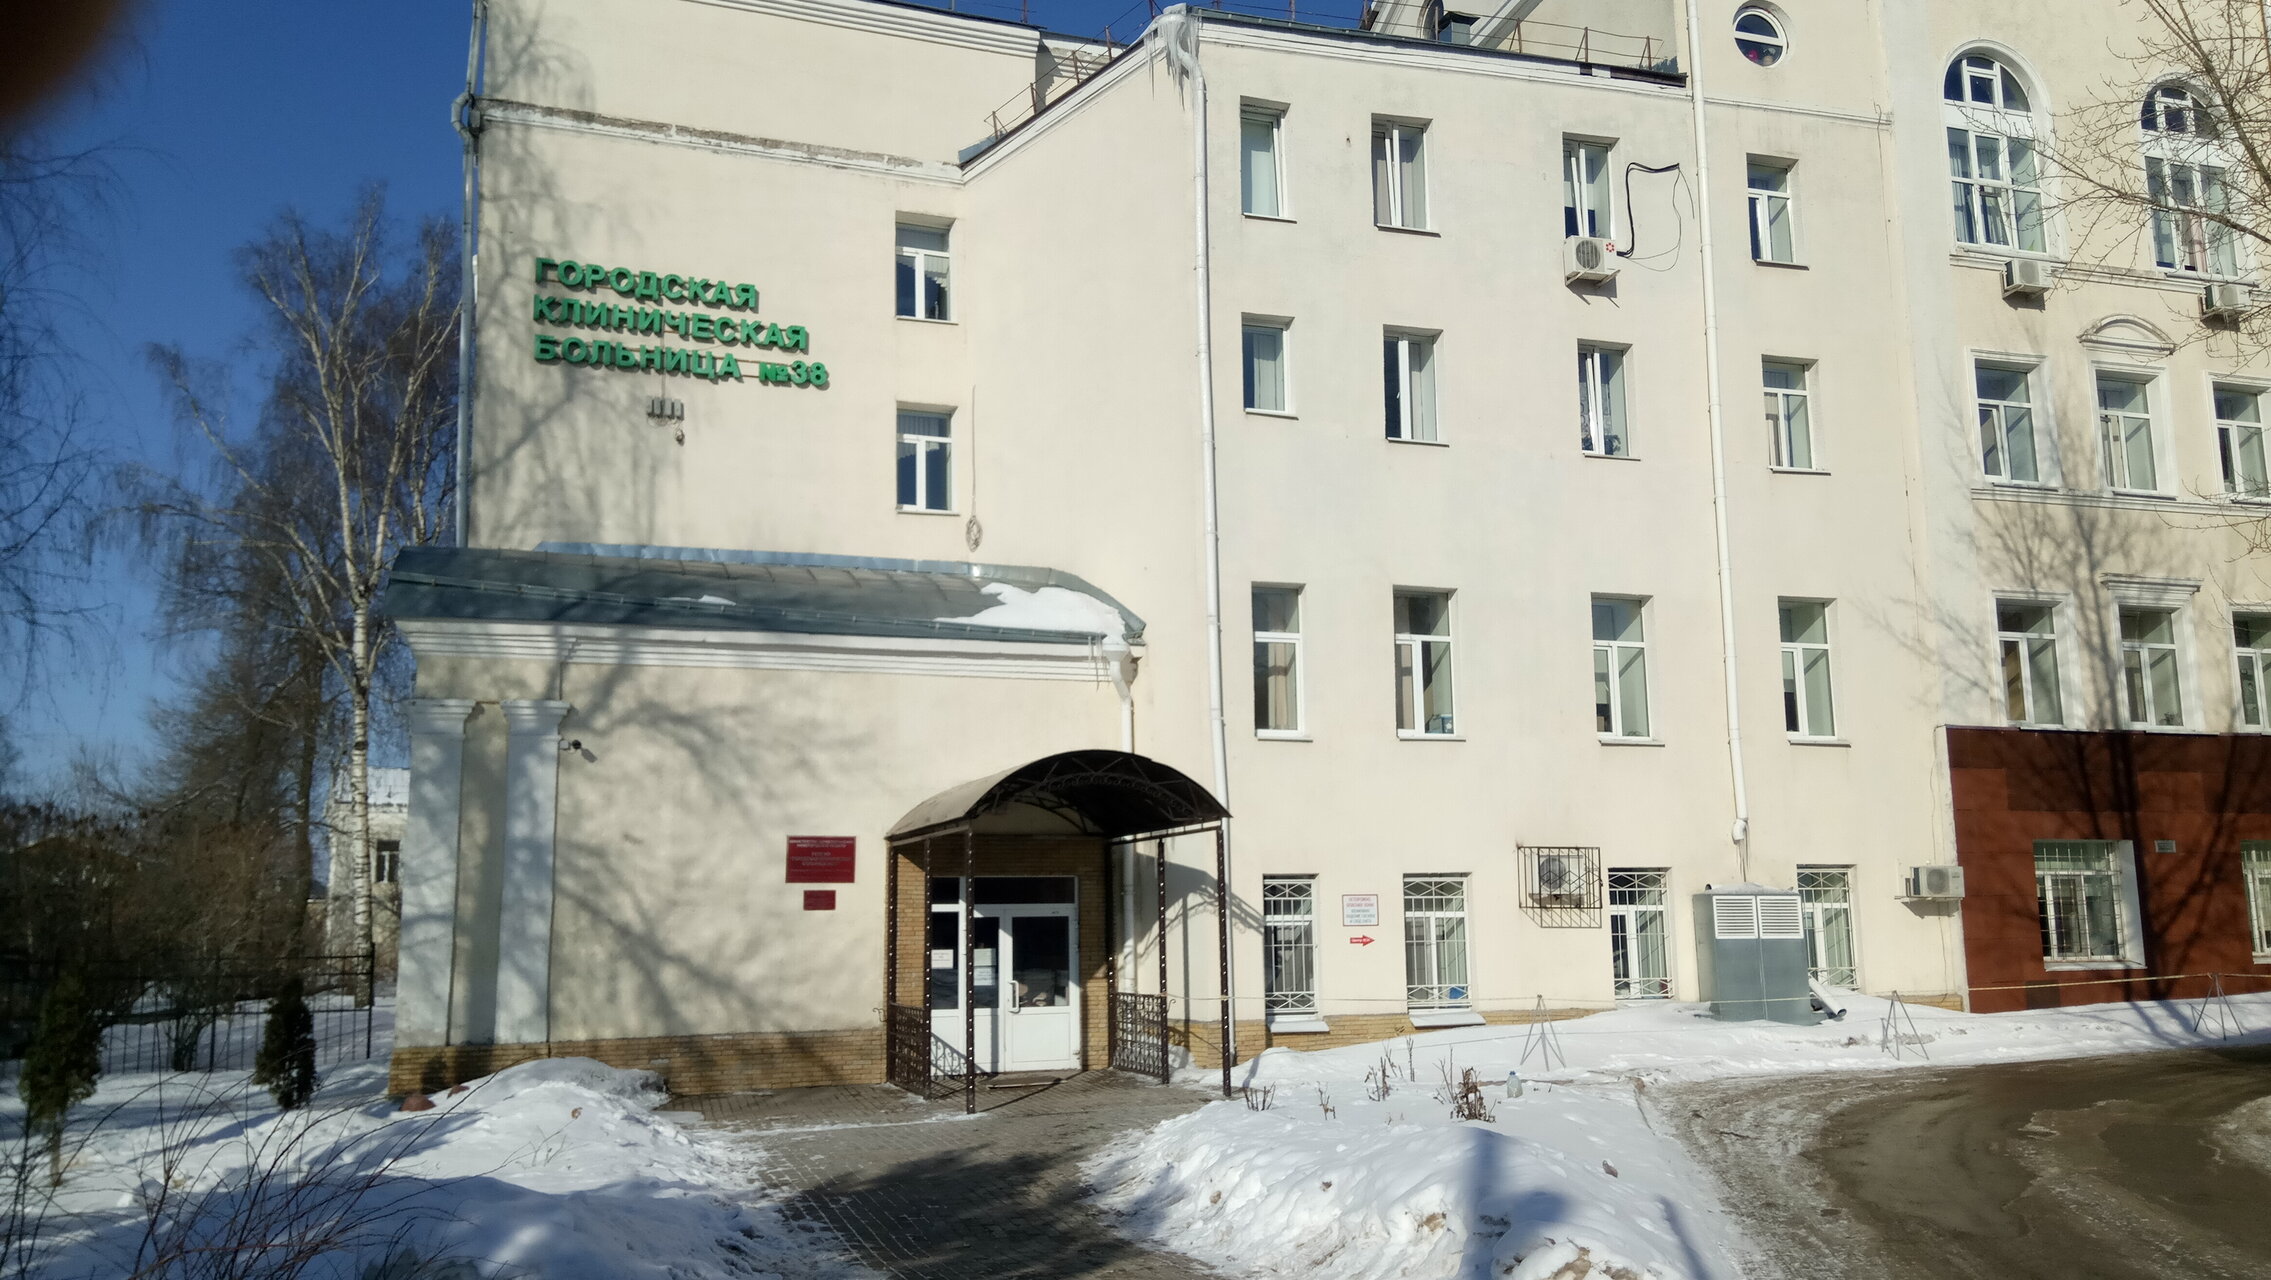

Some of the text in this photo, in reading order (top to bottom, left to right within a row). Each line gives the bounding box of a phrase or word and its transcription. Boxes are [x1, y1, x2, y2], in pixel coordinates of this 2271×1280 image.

[535, 257, 757, 308] ГОРОДСКАЯ
[533, 294, 807, 350] КЛИНИЧЕСКАЯ
[534, 334, 828, 387] БОЛЬНИЦА №38
